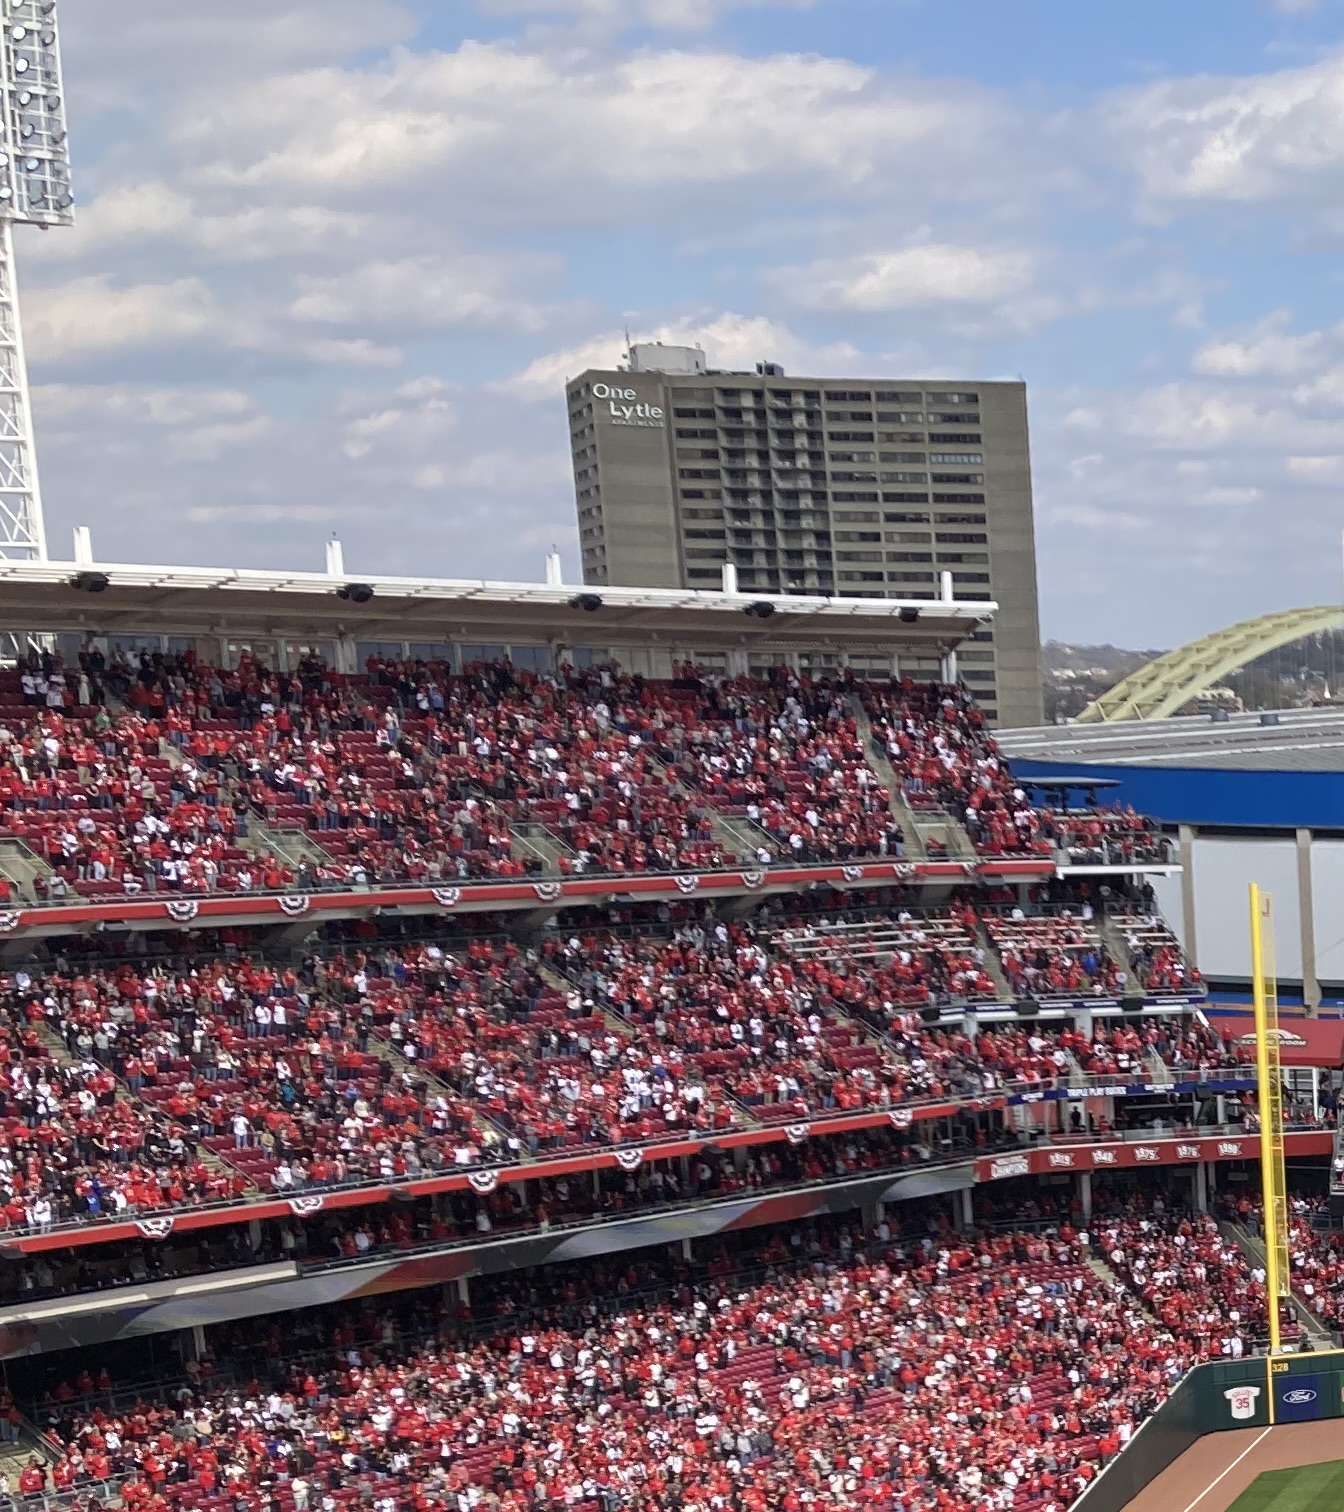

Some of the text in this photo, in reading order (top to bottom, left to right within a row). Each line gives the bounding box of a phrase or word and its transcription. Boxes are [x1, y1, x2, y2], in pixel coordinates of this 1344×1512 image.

[593, 383, 637, 400] One
[609, 401, 663, 419] Lytle
[1272, 1363, 1289, 1372] 328
